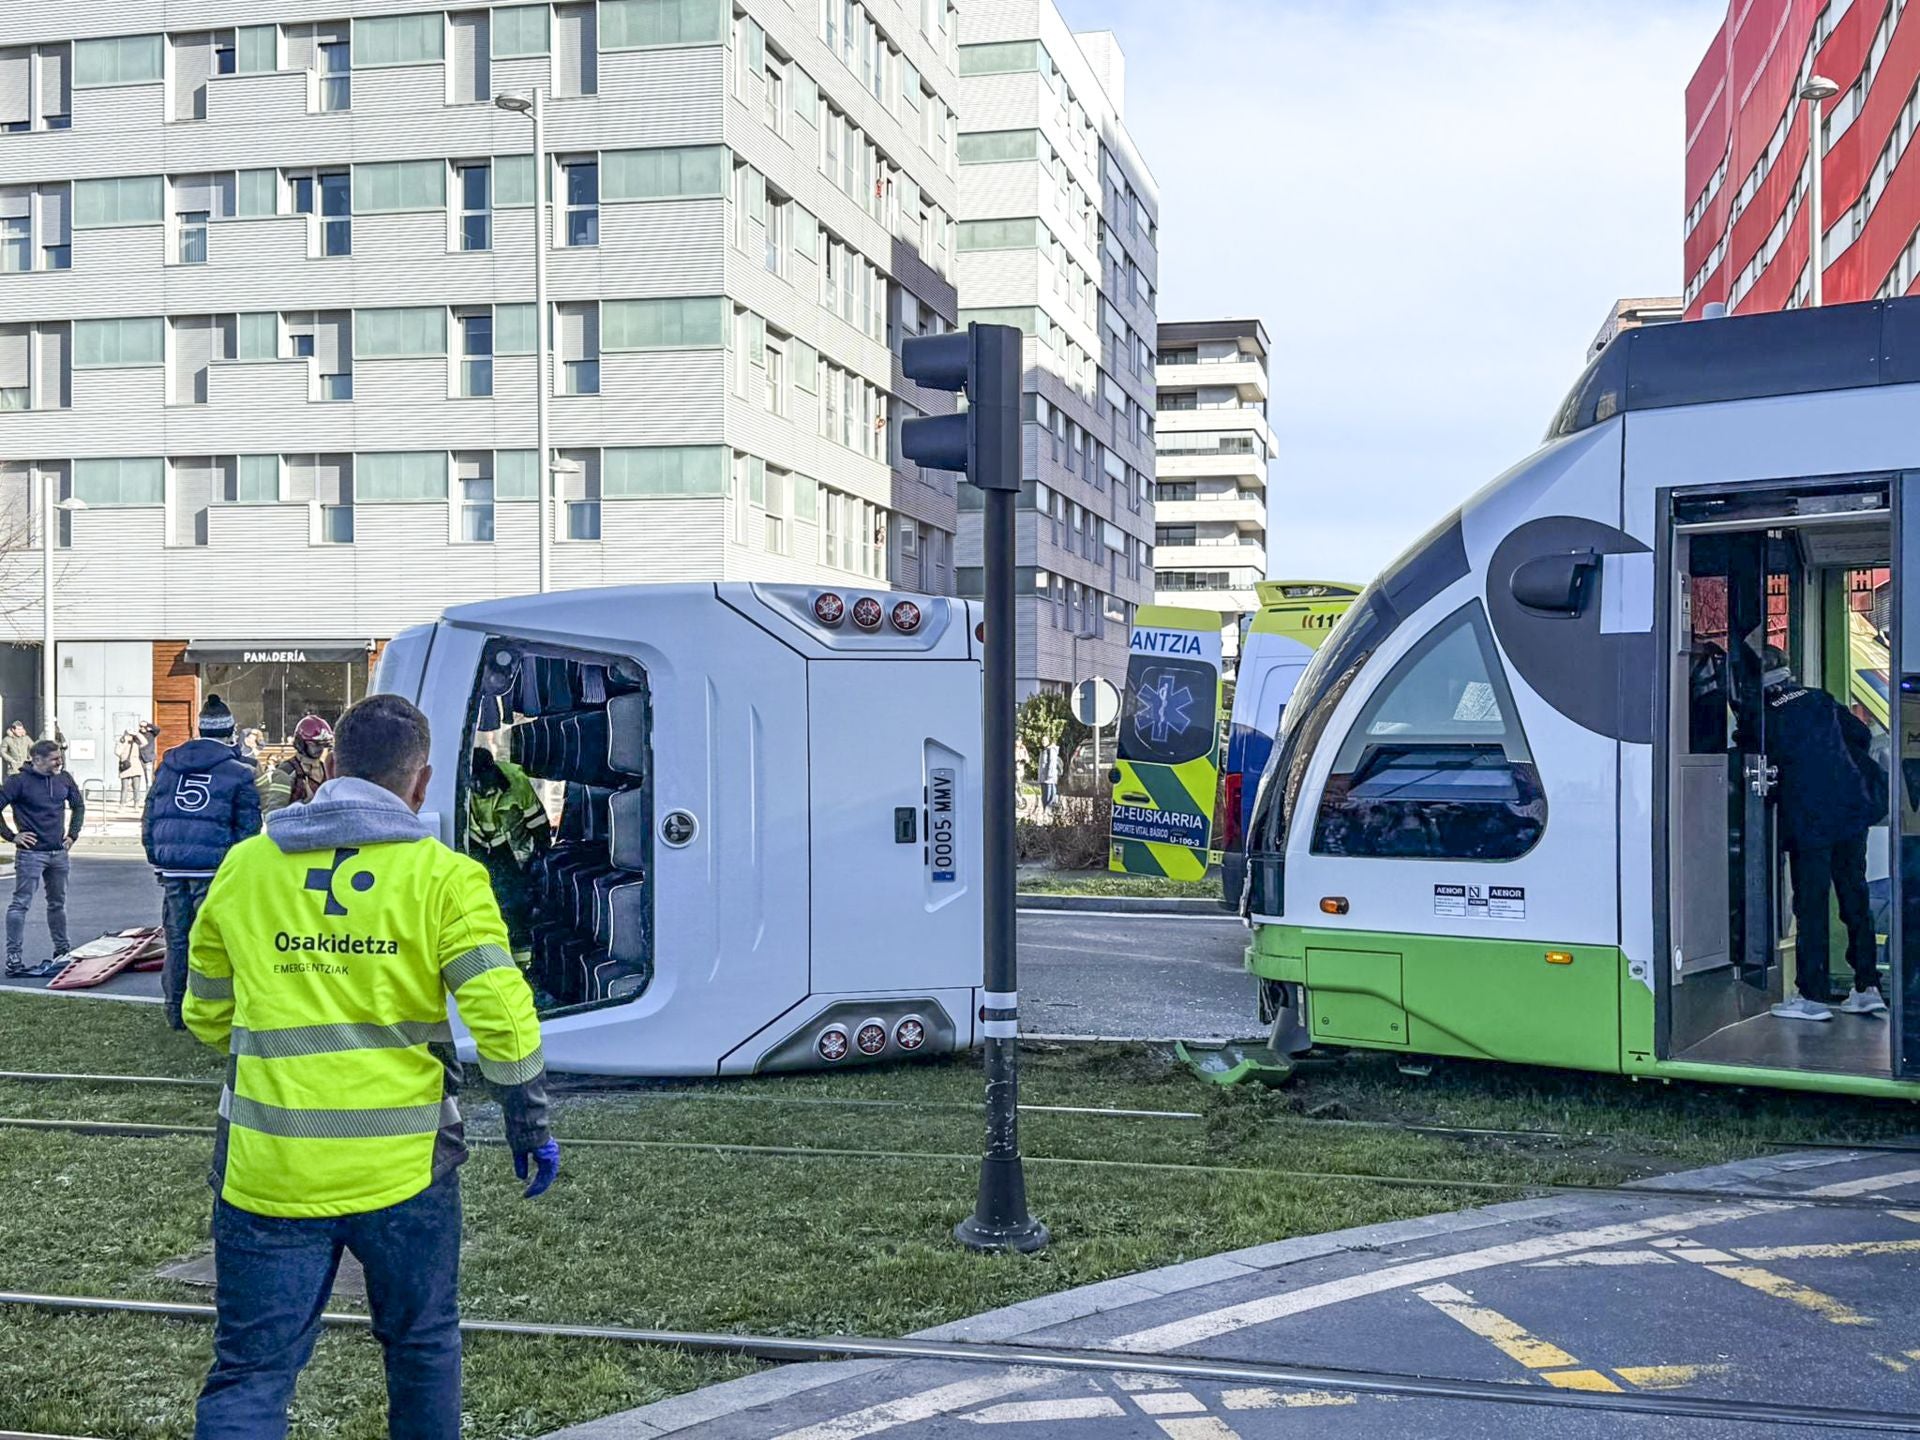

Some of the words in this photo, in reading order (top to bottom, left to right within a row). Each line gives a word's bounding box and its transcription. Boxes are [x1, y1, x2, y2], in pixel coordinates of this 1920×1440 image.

[1130, 631, 1201, 655] ANTZIA
[243, 649, 306, 663] PANADERÍA
[175, 773, 212, 812] 5
[934, 776, 951, 812] MMV
[934, 820, 952, 867] 0005
[1436, 887, 1463, 895] AENOR
[1491, 888, 1522, 898] AENOR
[274, 931, 398, 955] Osakidetza
[273, 962, 349, 975] EMERGENTZIAK
